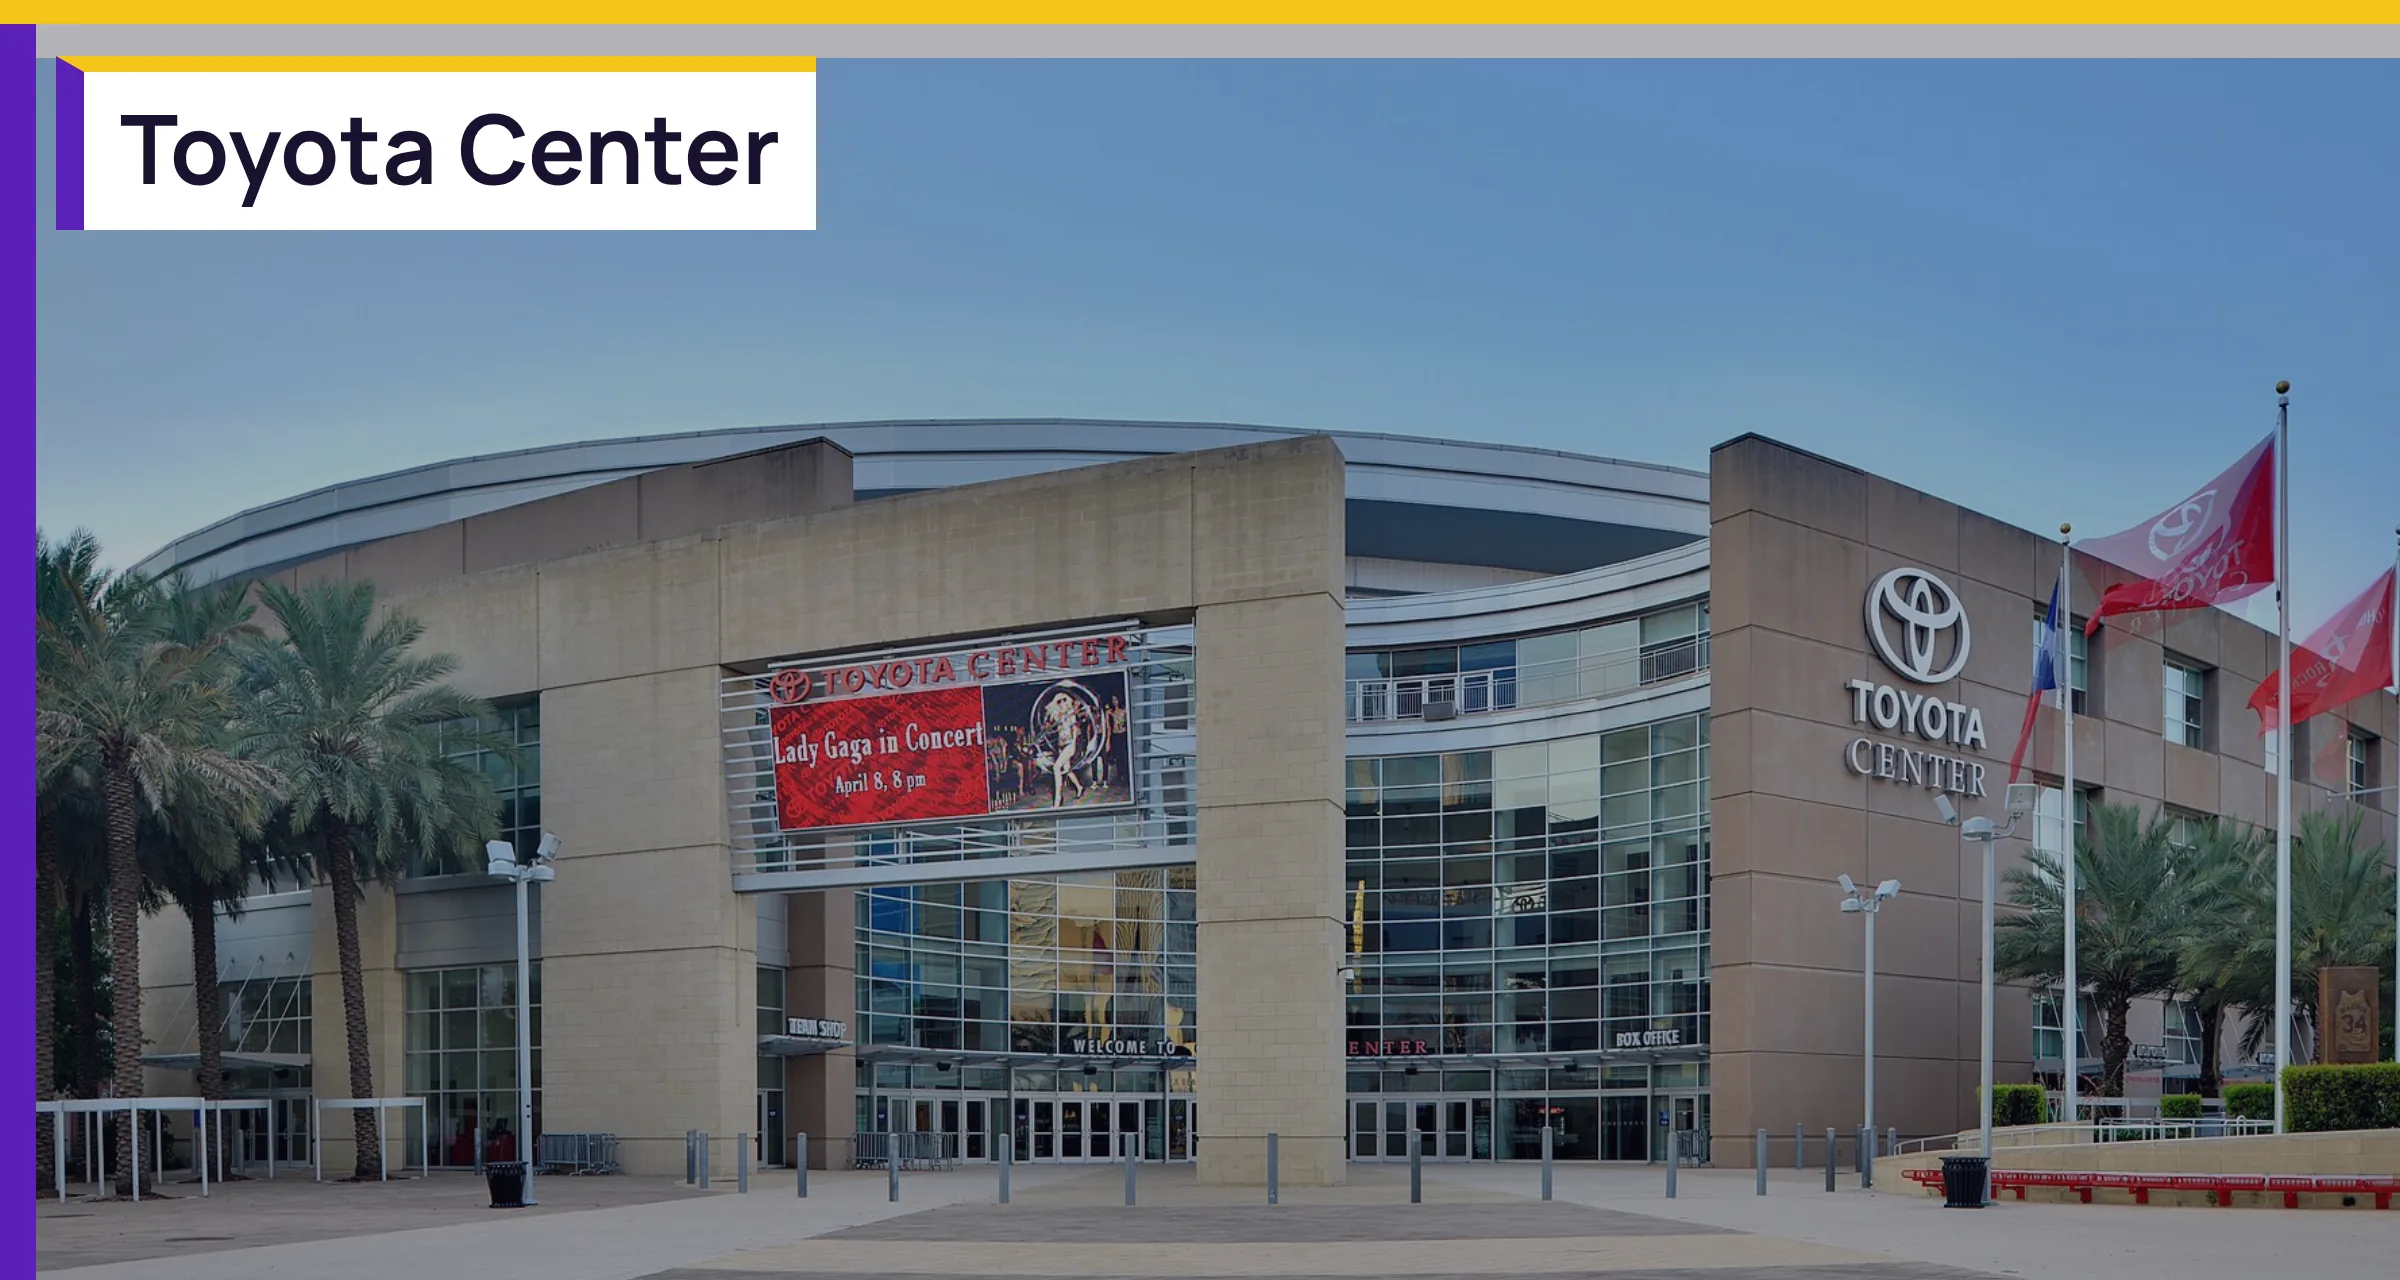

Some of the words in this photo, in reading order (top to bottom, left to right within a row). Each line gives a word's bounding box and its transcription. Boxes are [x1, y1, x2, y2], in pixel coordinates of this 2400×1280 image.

[821, 656, 956, 694] TOYOTA
[967, 635, 1129, 679] CENTER
[1845, 678, 1988, 750] TOYOTA
[773, 733, 819, 768] Lady
[824, 731, 873, 765] Gaga
[879, 728, 899, 754] in
[906, 721, 984, 751] Concert
[1845, 738, 1988, 797] CENTER
[835, 773, 868, 798] April
[873, 771, 888, 793] 8,
[892, 770, 902, 789] 8
[906, 774, 927, 792] pm
[788, 1016, 818, 1036] TEAM
[818, 1019, 847, 1040] SHOP
[2341, 1014, 2368, 1034] 34
[1073, 1039, 1146, 1054] WELCOME
[1156, 1041, 1176, 1055] TO
[1348, 1040, 1428, 1055] ENTER
[1616, 1031, 1641, 1047] BOX
[1643, 1029, 1680, 1046] OFFICE
